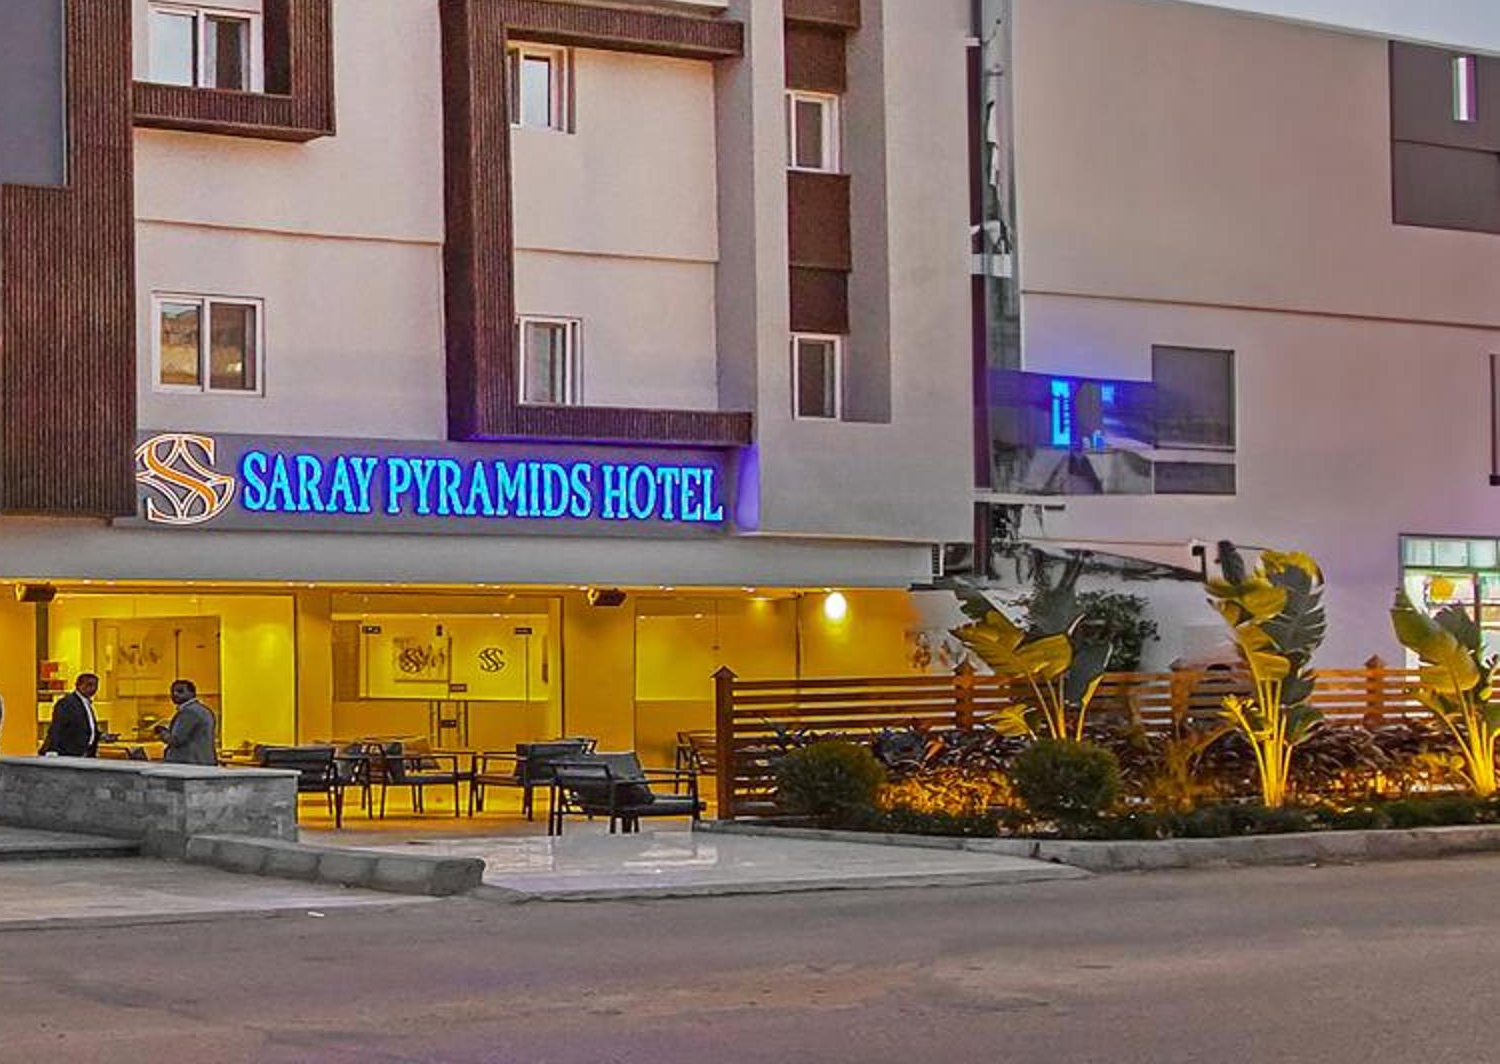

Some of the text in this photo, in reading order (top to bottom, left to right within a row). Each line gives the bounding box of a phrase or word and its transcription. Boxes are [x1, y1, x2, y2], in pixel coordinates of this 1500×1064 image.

[242, 450, 724, 522] SARAY PYRAMIDS HOTEL
